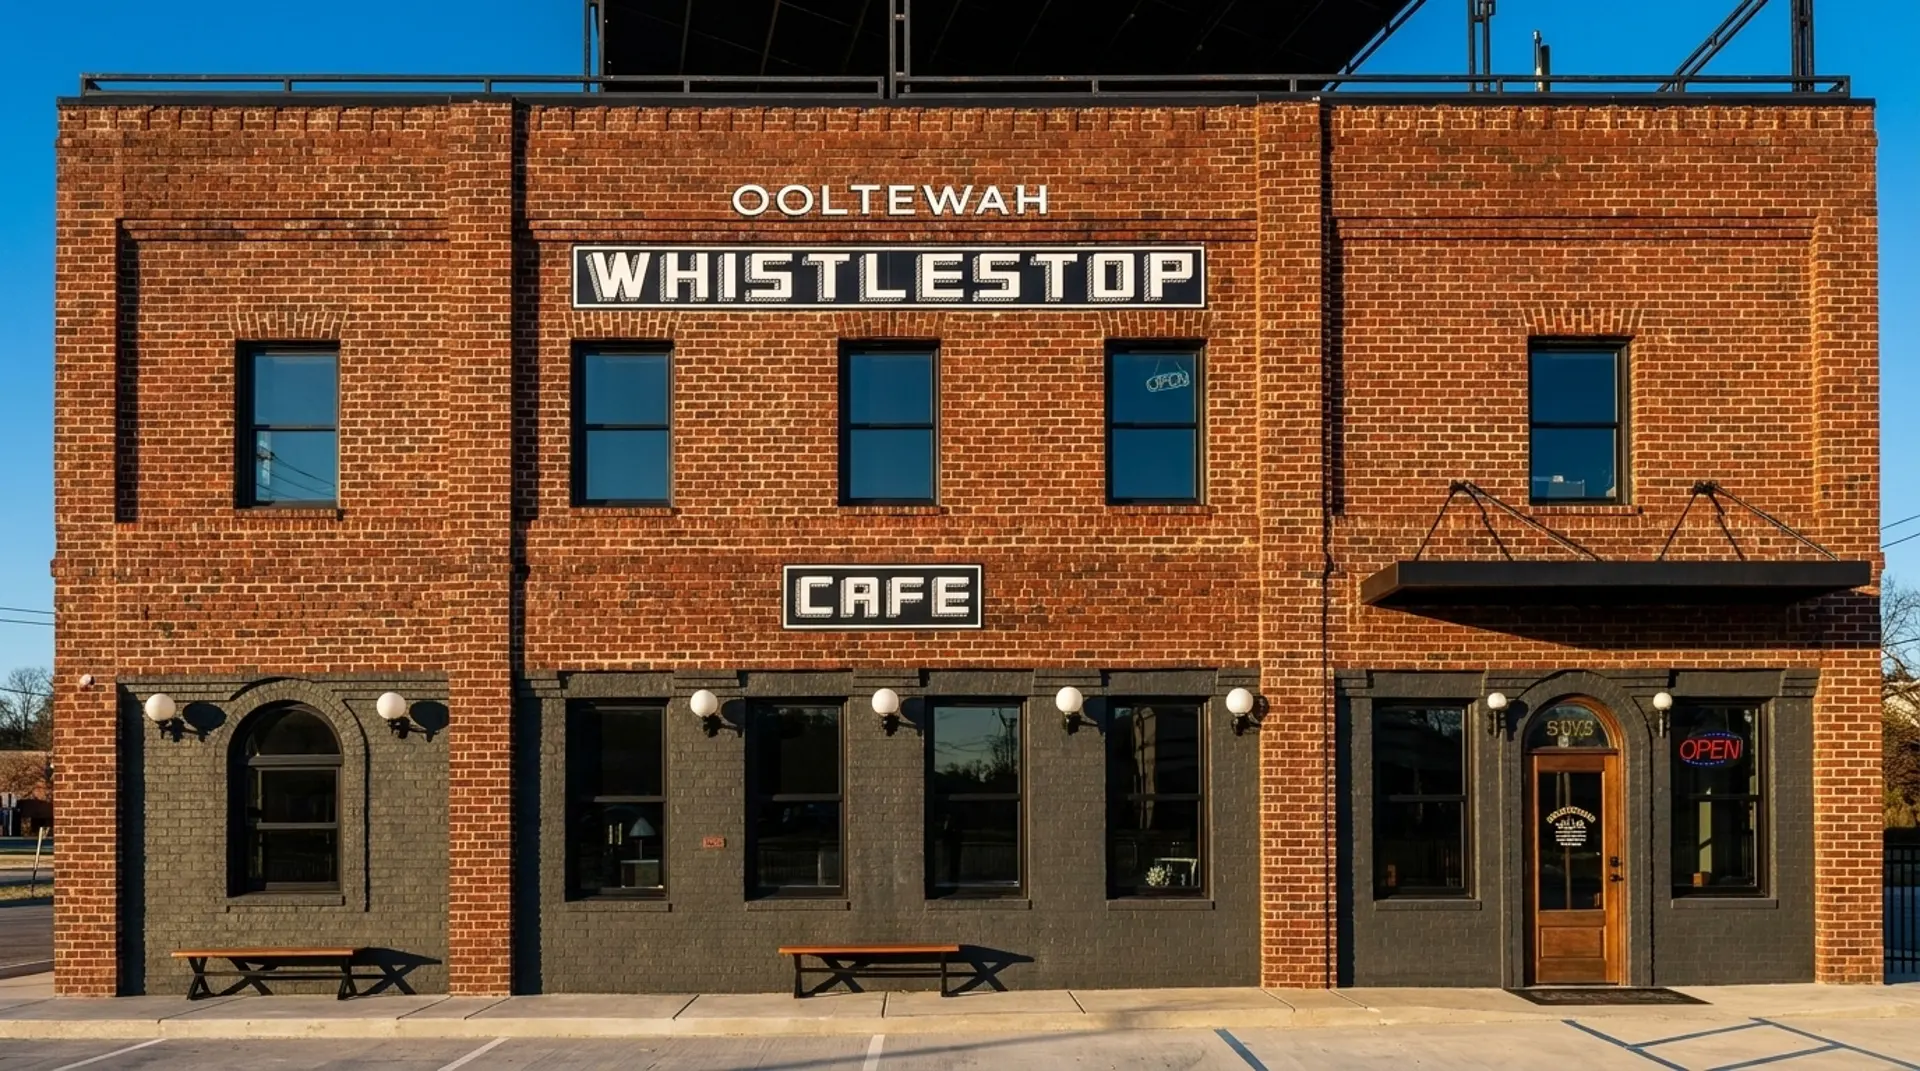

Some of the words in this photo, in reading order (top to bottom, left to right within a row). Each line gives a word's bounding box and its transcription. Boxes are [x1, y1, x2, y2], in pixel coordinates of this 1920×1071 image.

[731, 184, 1048, 216] OOLTEWAH
[585, 252, 1194, 302] WHISTLESTOP
[795, 576, 970, 618] CAFE
[1680, 739, 1740, 760] OPEN
